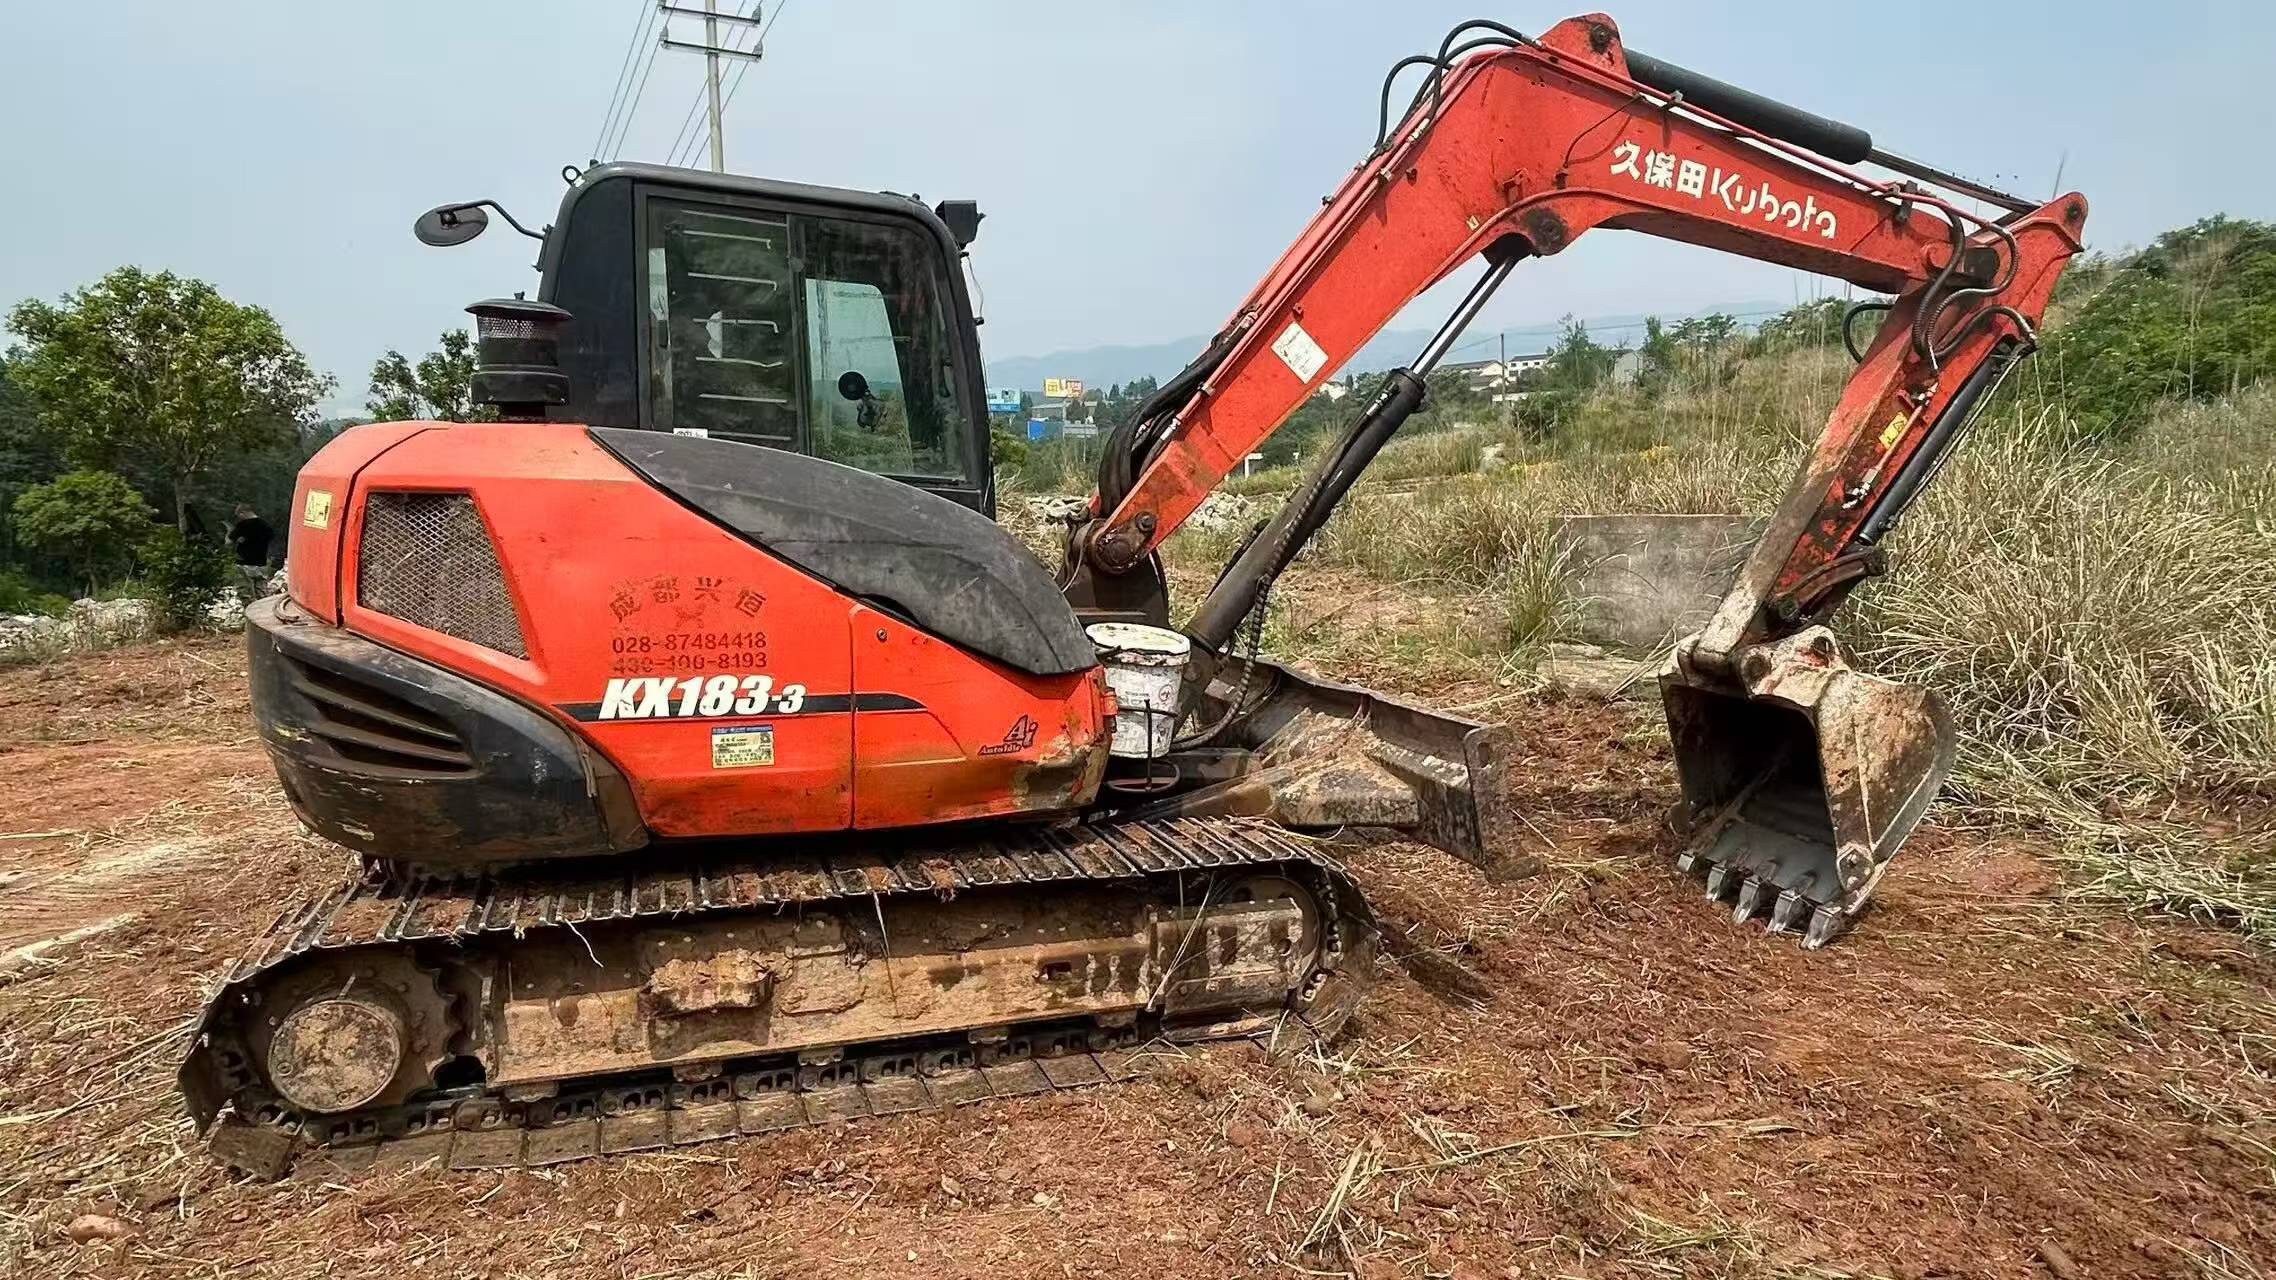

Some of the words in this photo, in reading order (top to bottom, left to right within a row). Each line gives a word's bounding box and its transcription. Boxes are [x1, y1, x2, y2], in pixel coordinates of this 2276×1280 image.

[1610, 140, 1708, 199] 久保田
[1711, 167, 1838, 240] Kubota
[612, 631, 768, 654] 028-87484418
[598, 674, 807, 720] KX183-3
